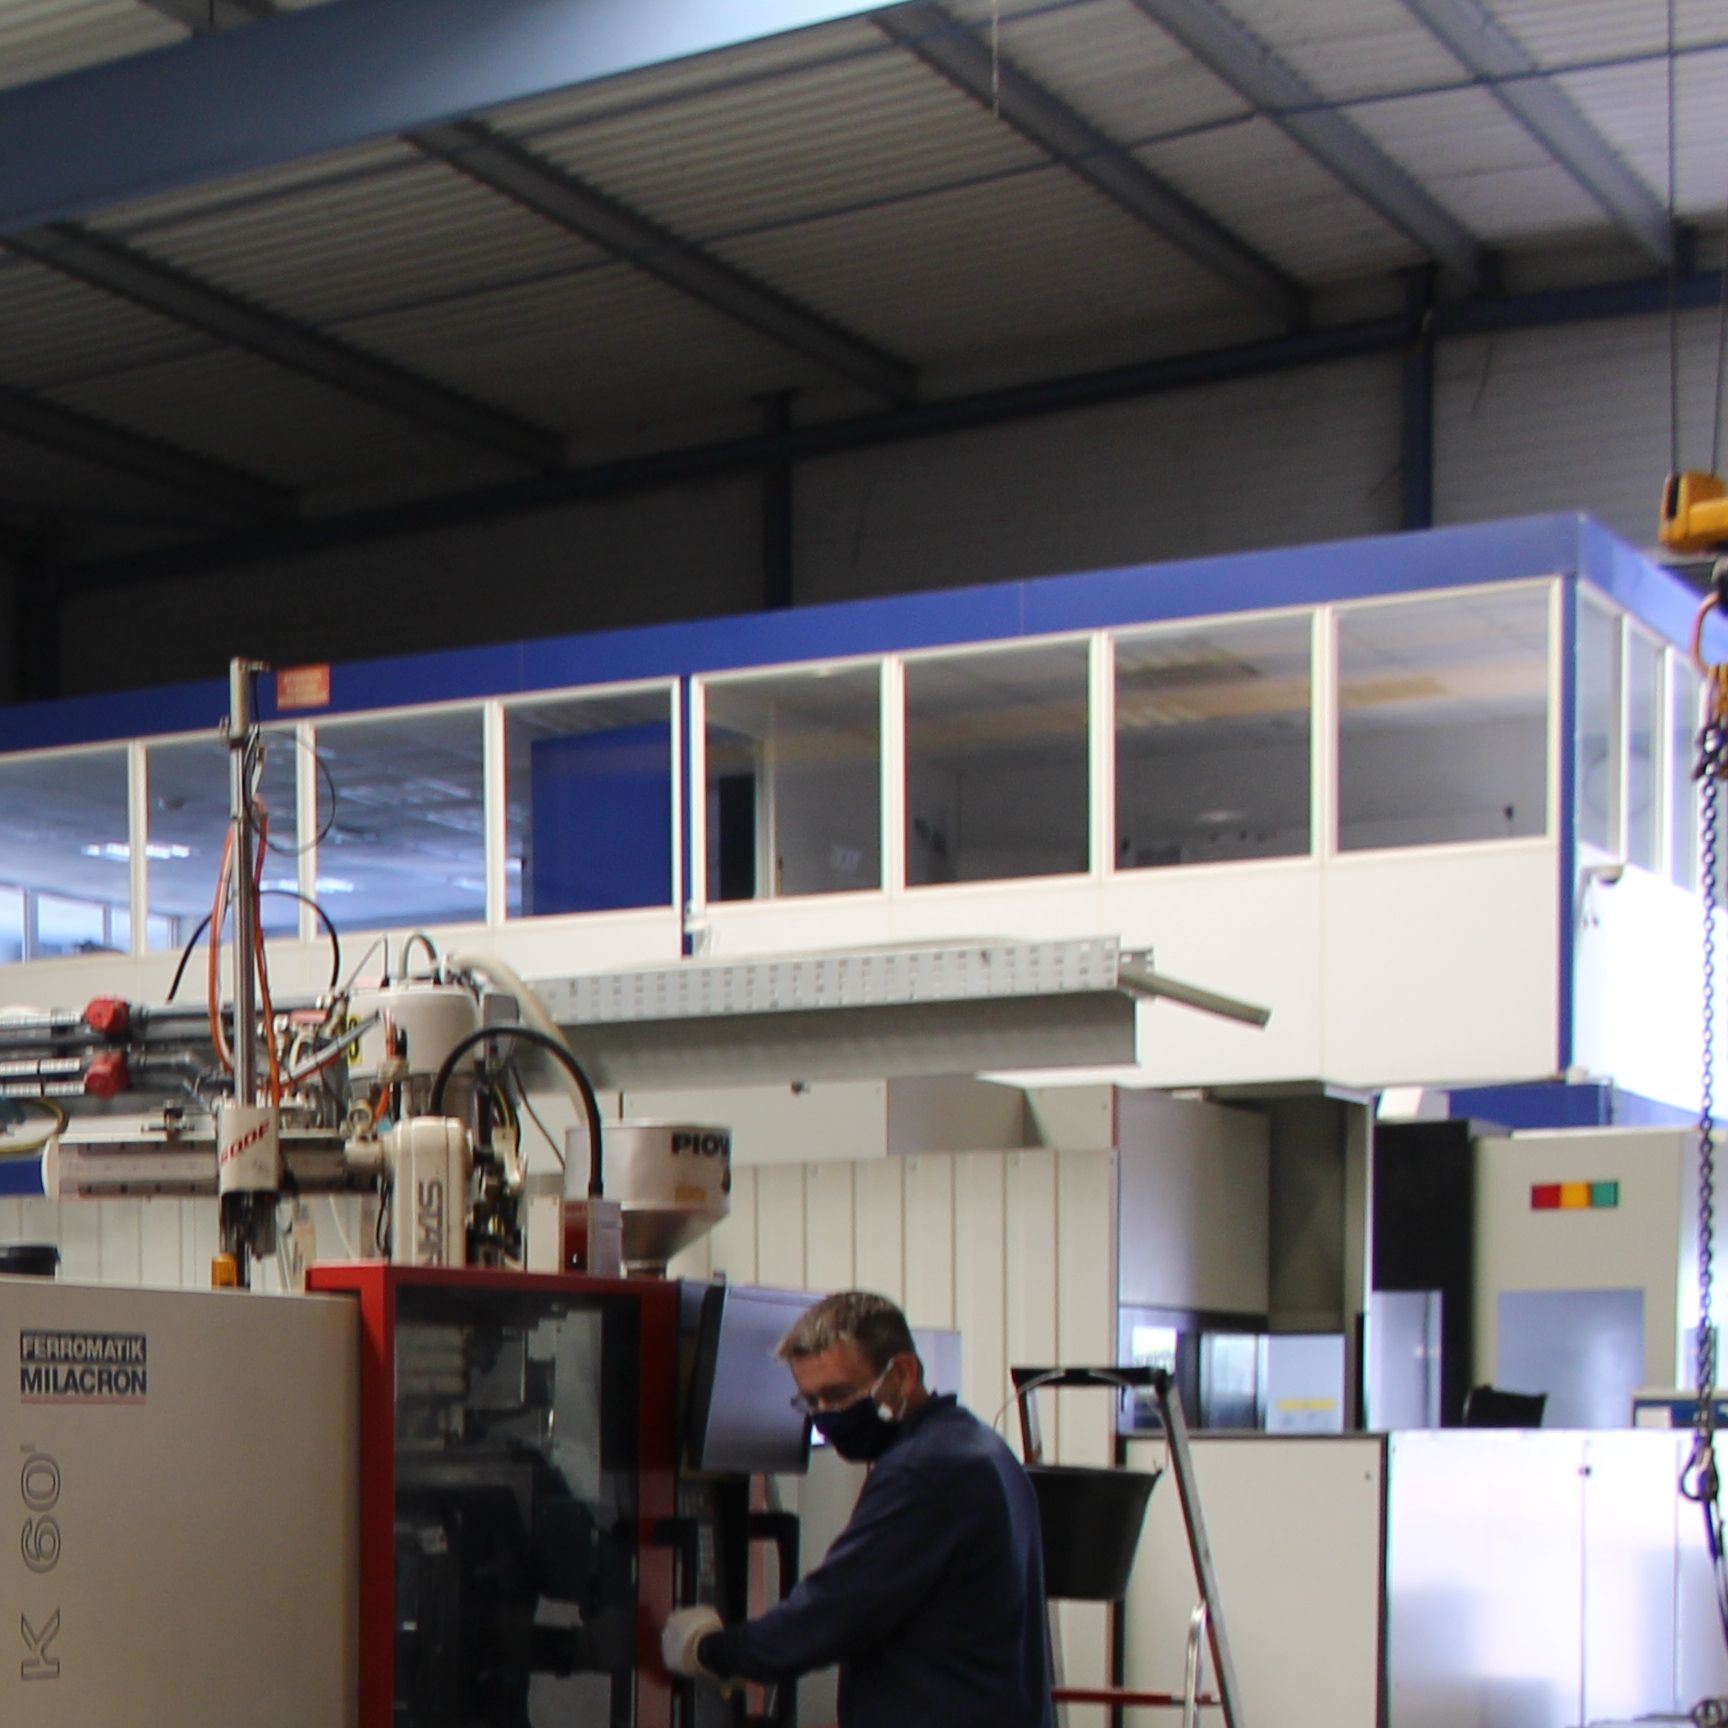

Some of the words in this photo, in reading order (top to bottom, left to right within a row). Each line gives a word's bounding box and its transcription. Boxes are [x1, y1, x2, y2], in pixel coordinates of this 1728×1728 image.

[22, 1334, 146, 1362] FERROMATIK
[21, 1366, 147, 1395] MILACRON
[21, 1452, 61, 1574] 60
[21, 1607, 60, 1681] K
